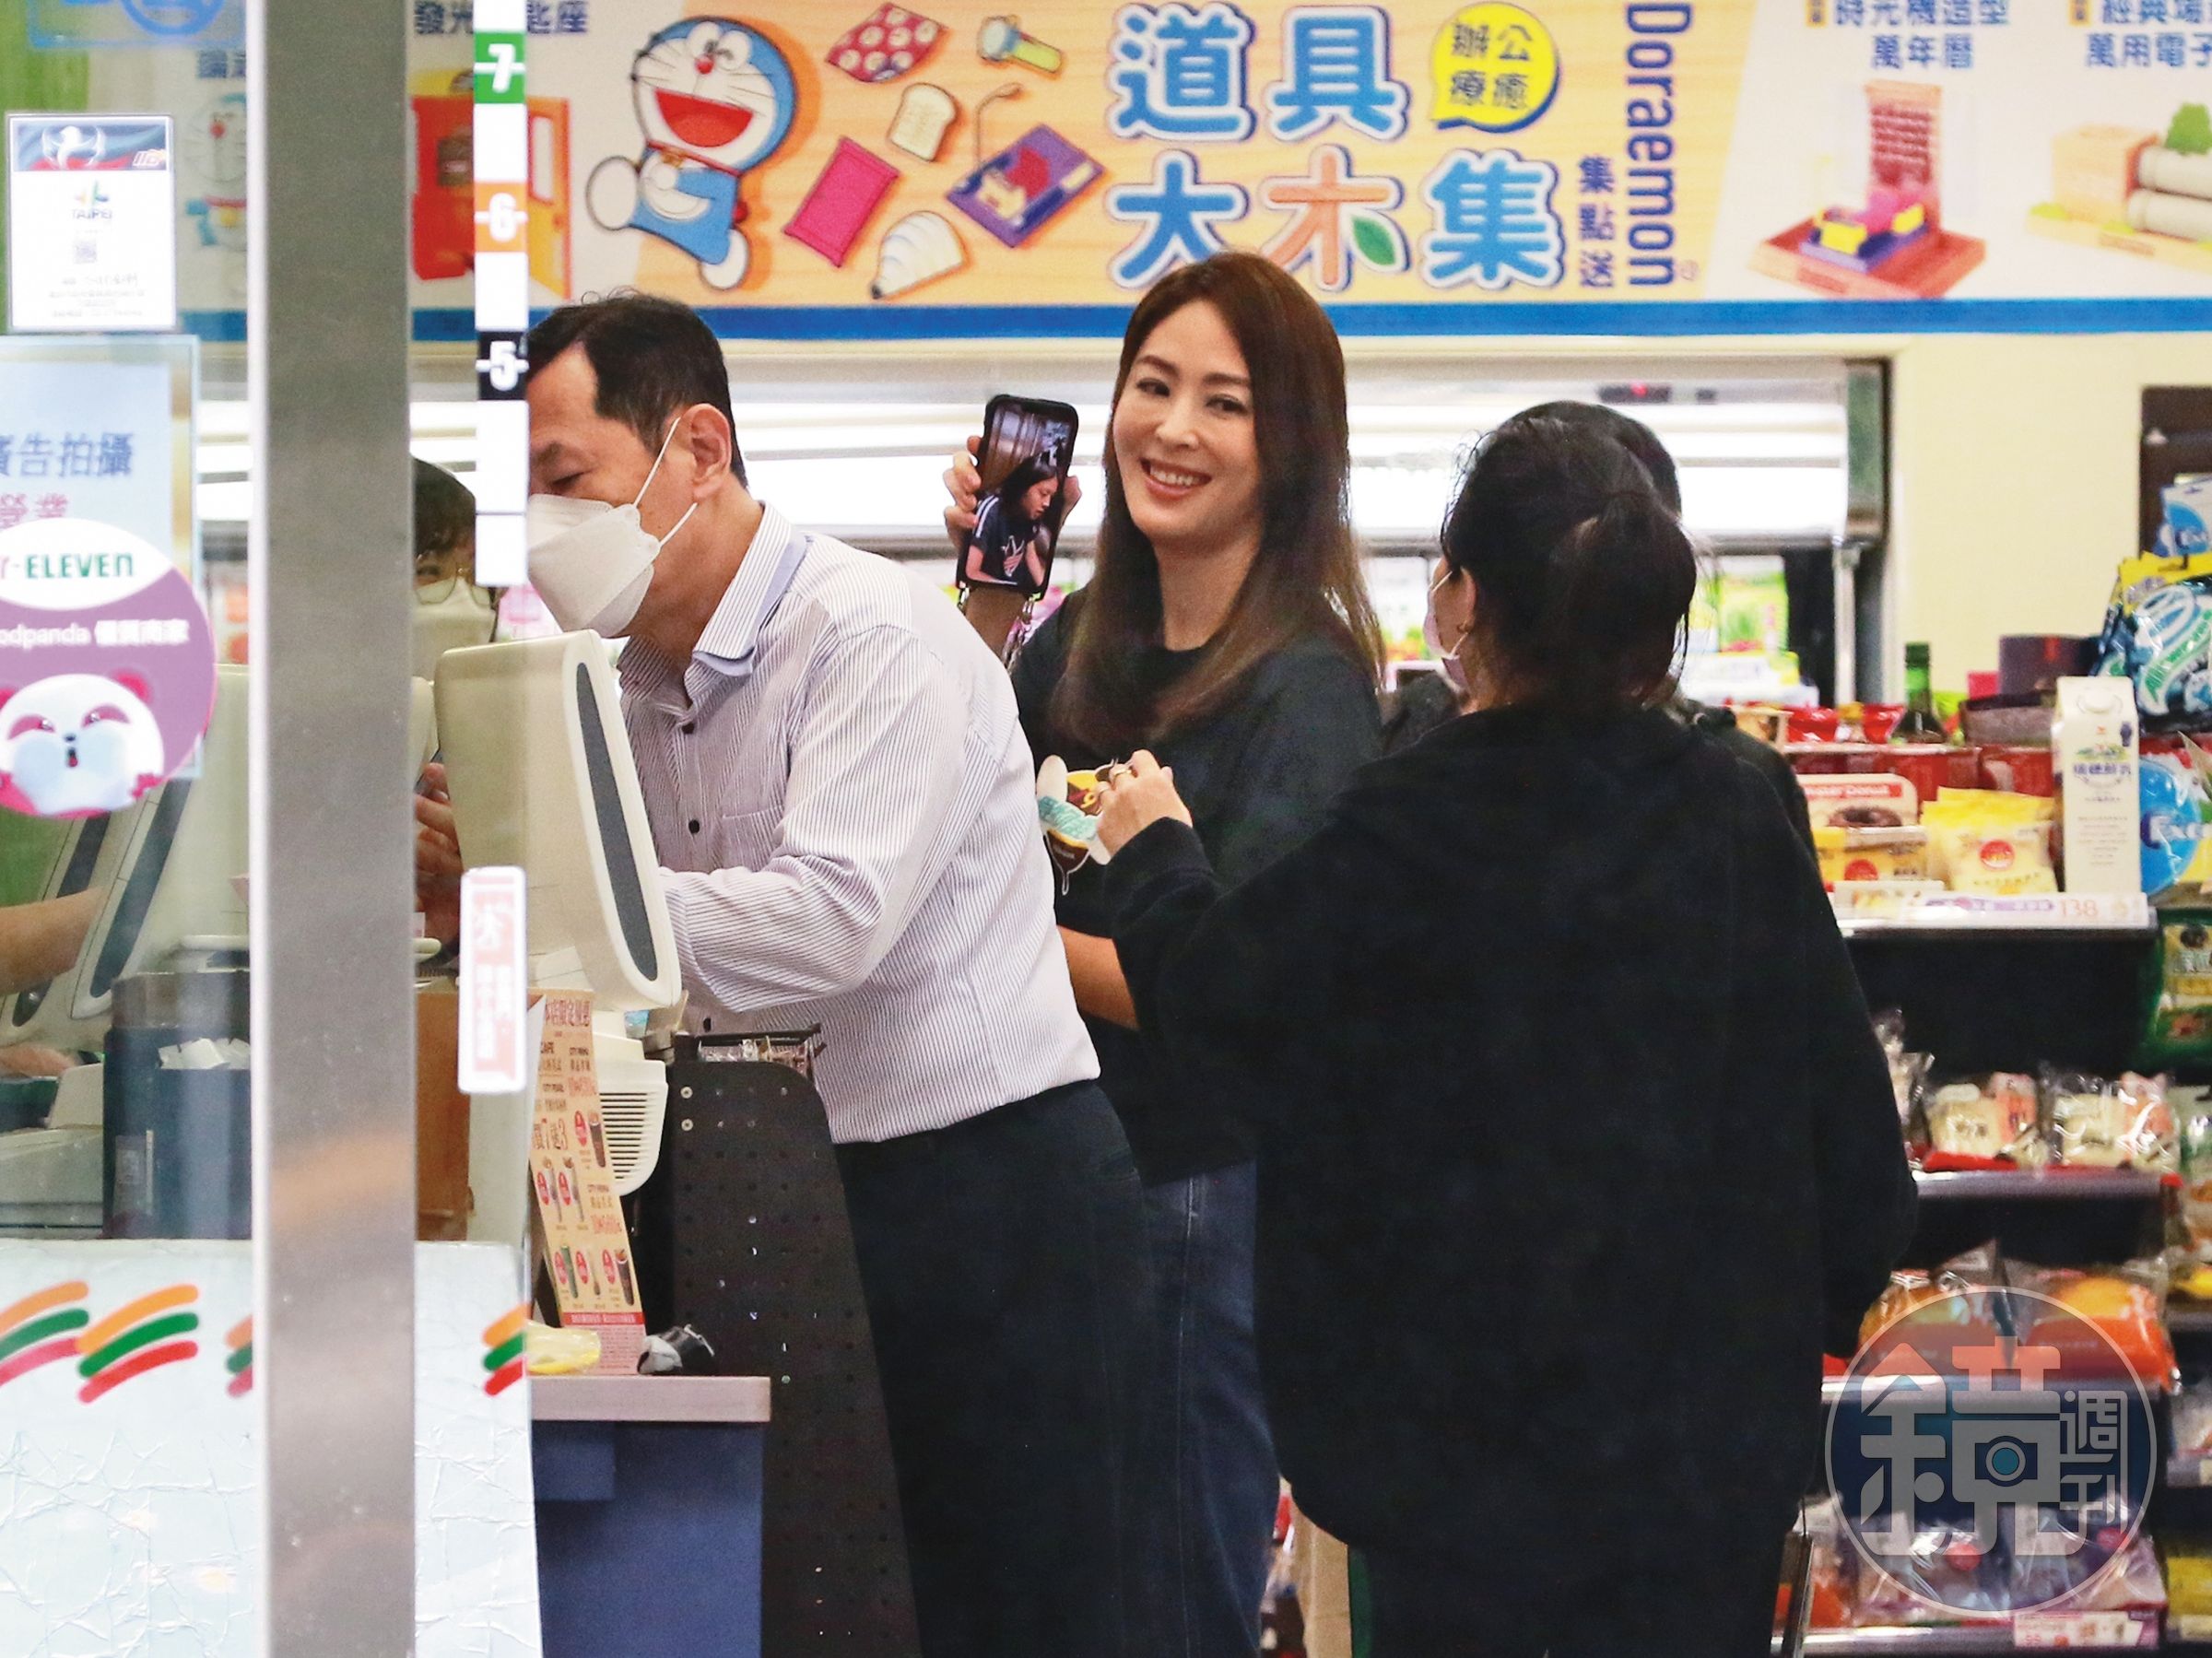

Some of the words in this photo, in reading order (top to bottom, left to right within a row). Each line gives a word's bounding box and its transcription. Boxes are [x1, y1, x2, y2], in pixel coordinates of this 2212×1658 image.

[1453, 23, 1533, 61] 辦公
[488, 43, 515, 93] 7
[1108, 3, 1410, 141] 道具
[1451, 69, 1530, 110] 療癒
[1626, 3, 1692, 287] Doraemon
[488, 192, 517, 242] 6
[1109, 147, 1564, 289] 大木集
[488, 340, 518, 392] 5
